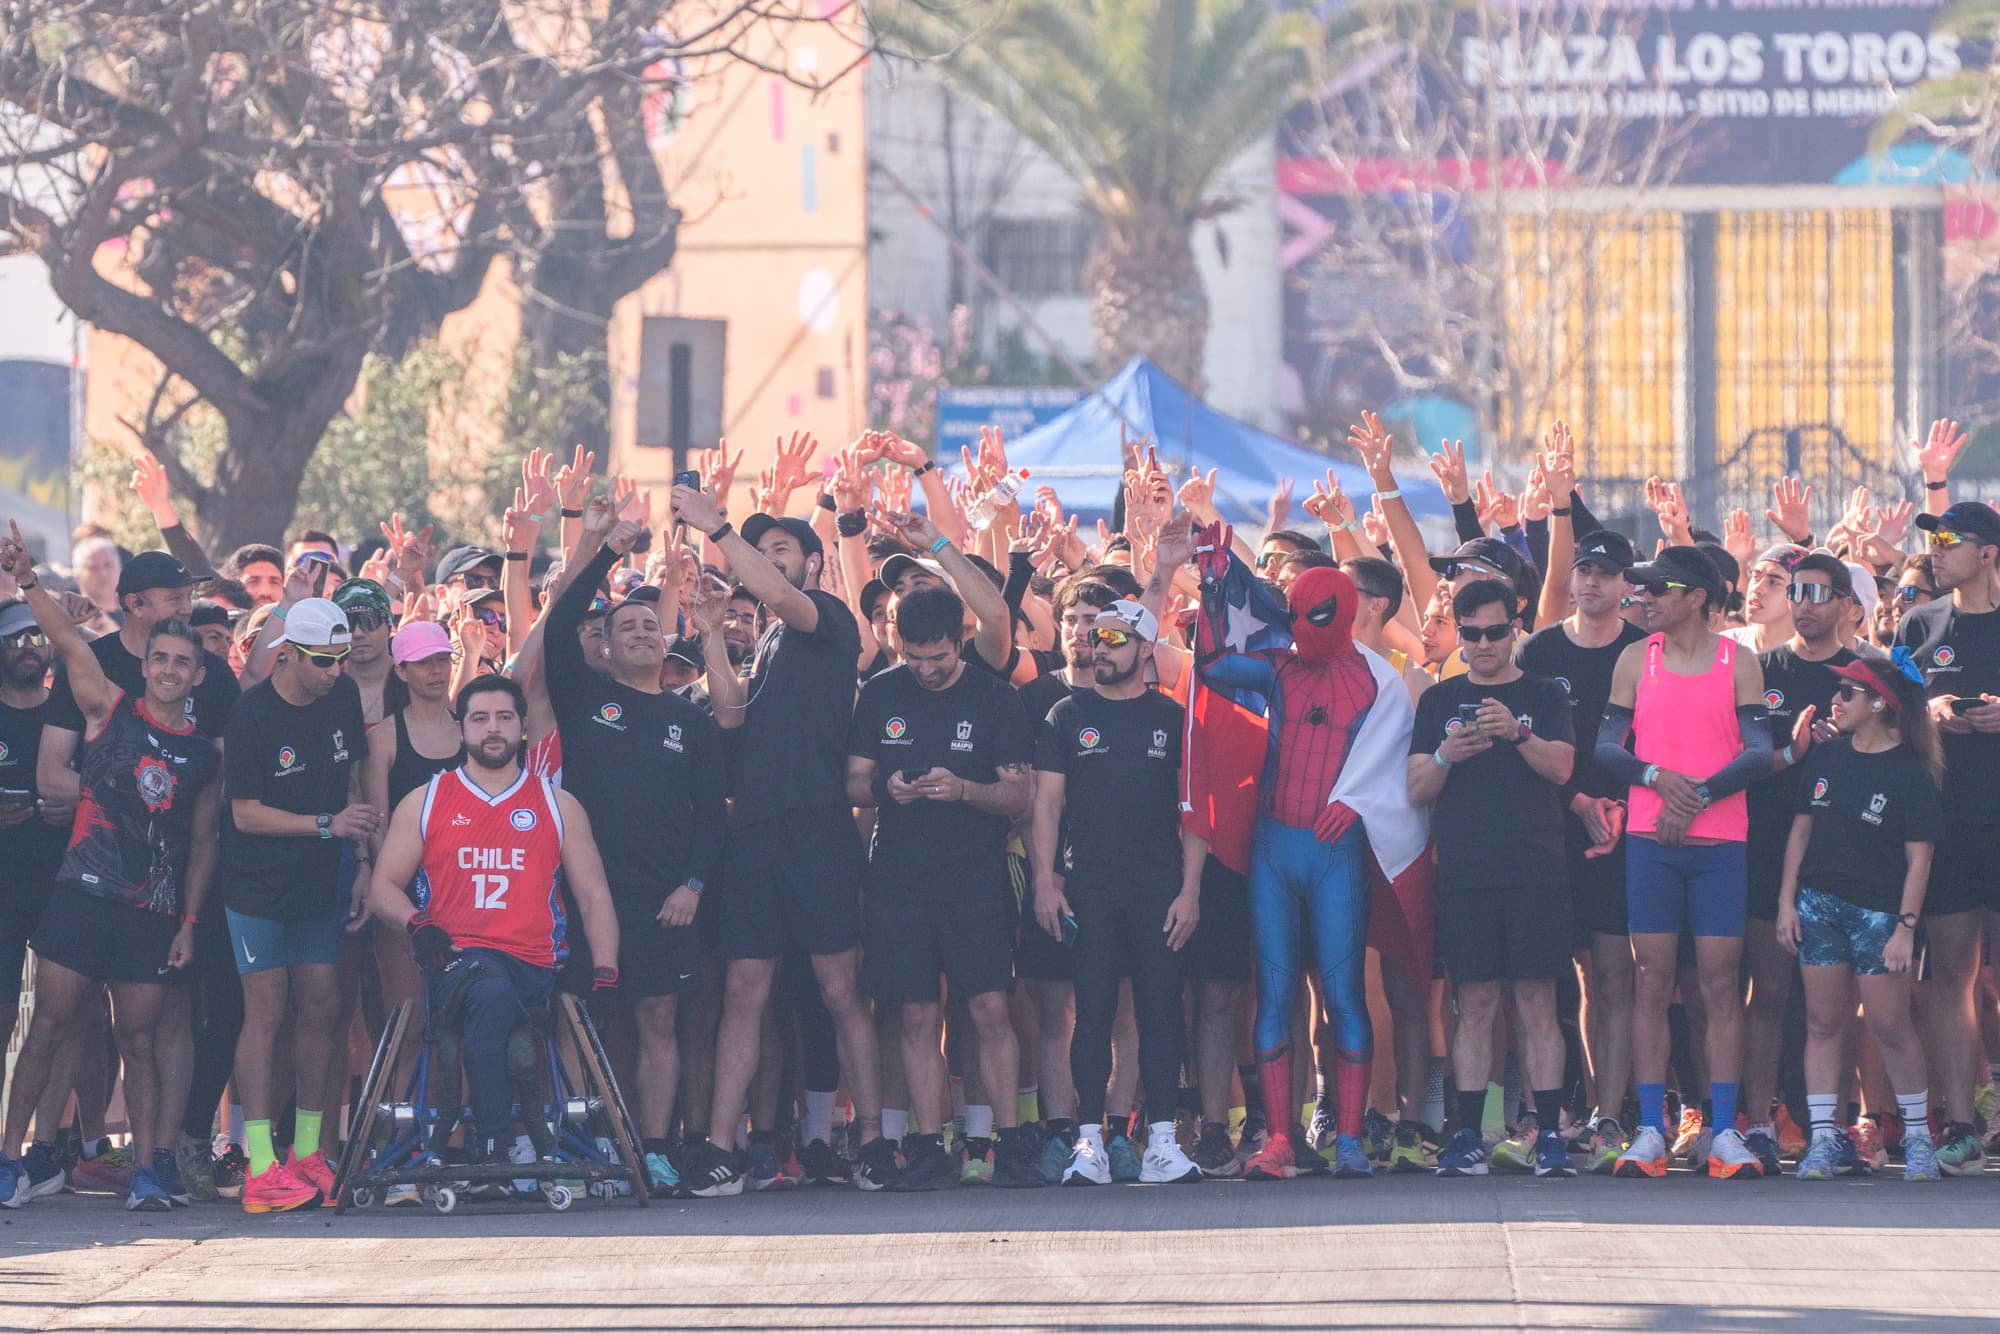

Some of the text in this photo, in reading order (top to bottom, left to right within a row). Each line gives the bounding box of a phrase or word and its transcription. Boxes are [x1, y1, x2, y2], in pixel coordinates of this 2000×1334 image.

[1461, 31, 1962, 85] PLAZA LOS TOROS
[1699, 88, 1770, 117] SITIO
[1773, 88, 1811, 117] DE
[458, 847, 525, 870] CHILE
[471, 874, 510, 910] 12
